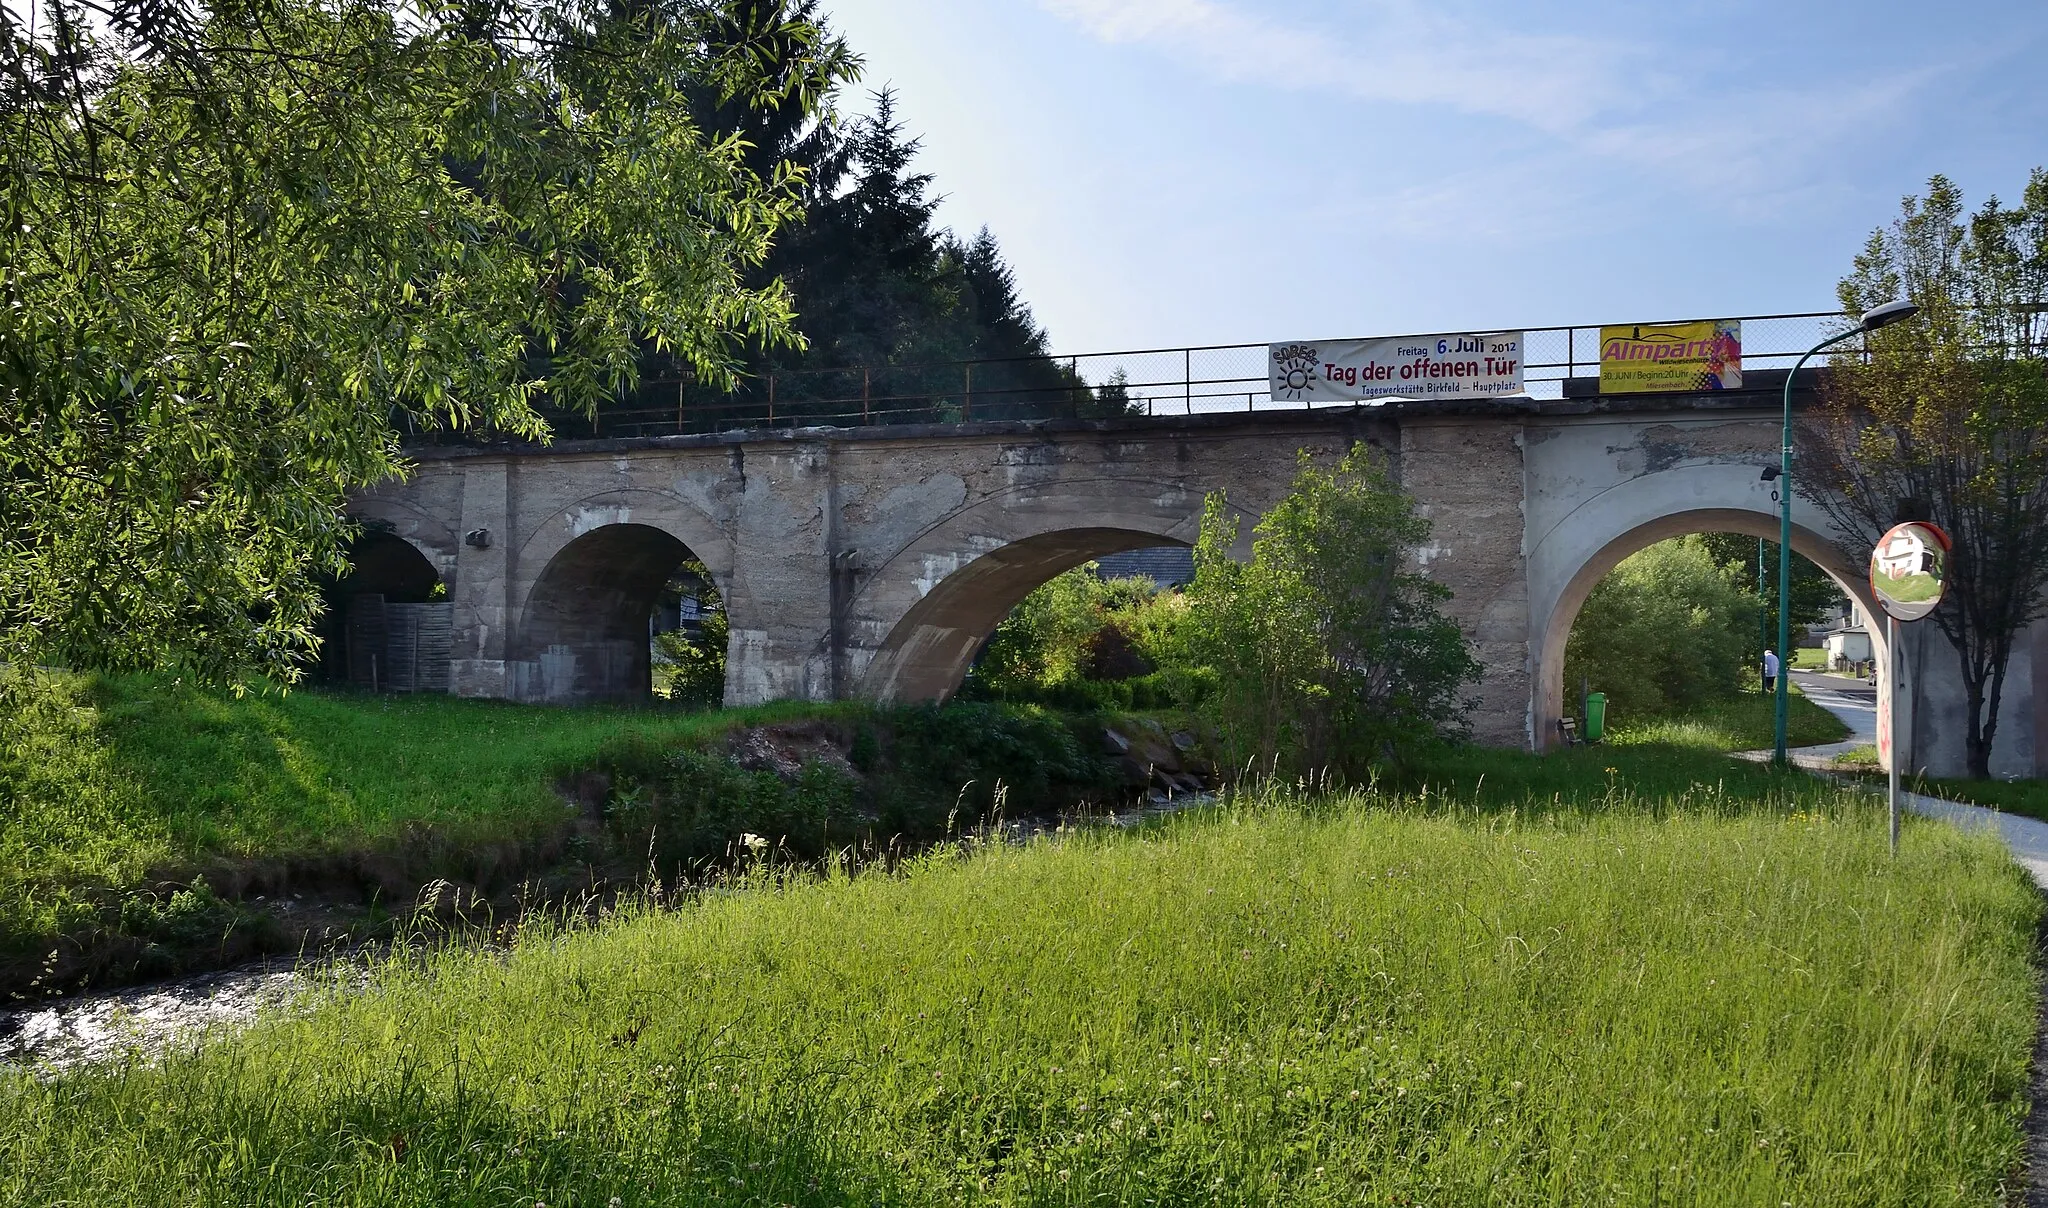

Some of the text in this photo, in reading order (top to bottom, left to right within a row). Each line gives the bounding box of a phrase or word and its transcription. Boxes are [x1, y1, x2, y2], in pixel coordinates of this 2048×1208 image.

[1397, 346, 1428, 357] Freitag
[1491, 342, 1516, 353] 2012
[1324, 357, 1517, 386] Tag der offenen Tür
[1603, 372, 1614, 381] 30.
[1614, 371, 1632, 380] JUNI
[1675, 370, 1689, 378] Uhr
[1361, 384, 1424, 397] Tageswerkstätte
[1427, 382, 1460, 393] Birkfeld
[1473, 381, 1516, 393] Hauptplatz
